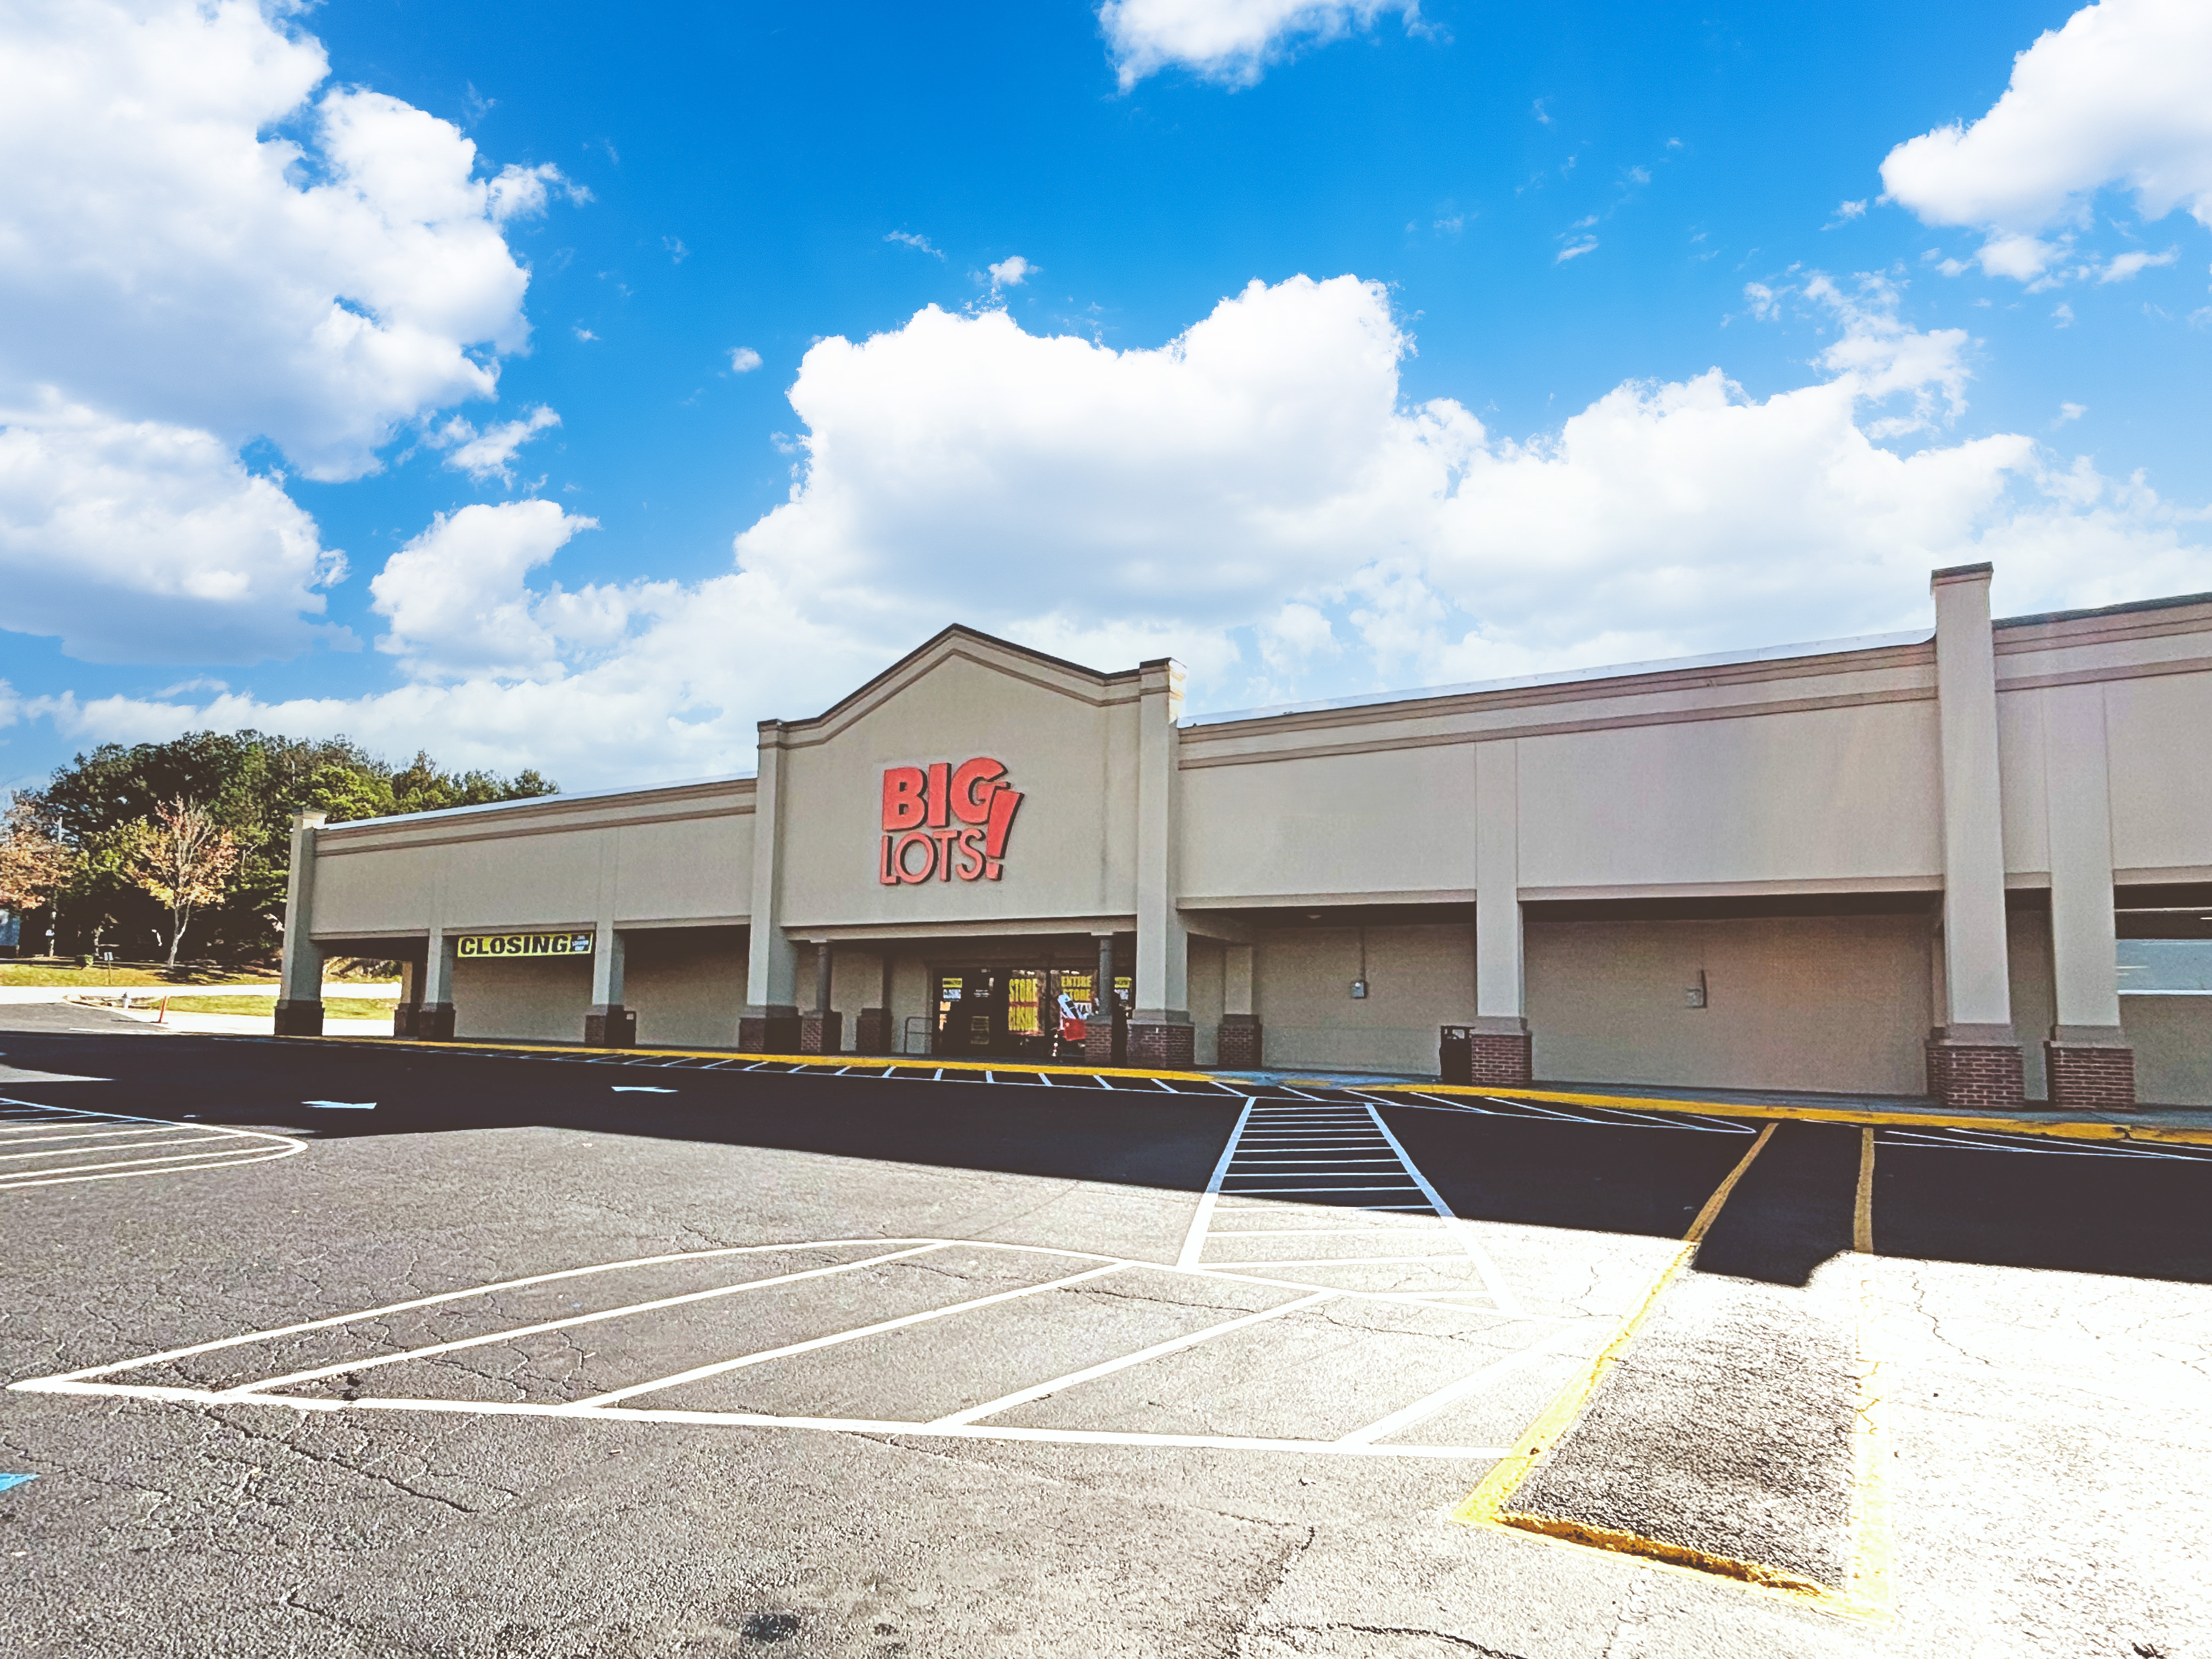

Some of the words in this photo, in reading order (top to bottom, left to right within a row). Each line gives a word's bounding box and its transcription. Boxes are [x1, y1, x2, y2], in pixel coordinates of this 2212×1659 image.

[882, 757, 1011, 831] BIG
[880, 789, 1025, 885] LOTS!
[460, 935, 568, 955] CLOSING
[1009, 979, 1038, 1002] STORE
